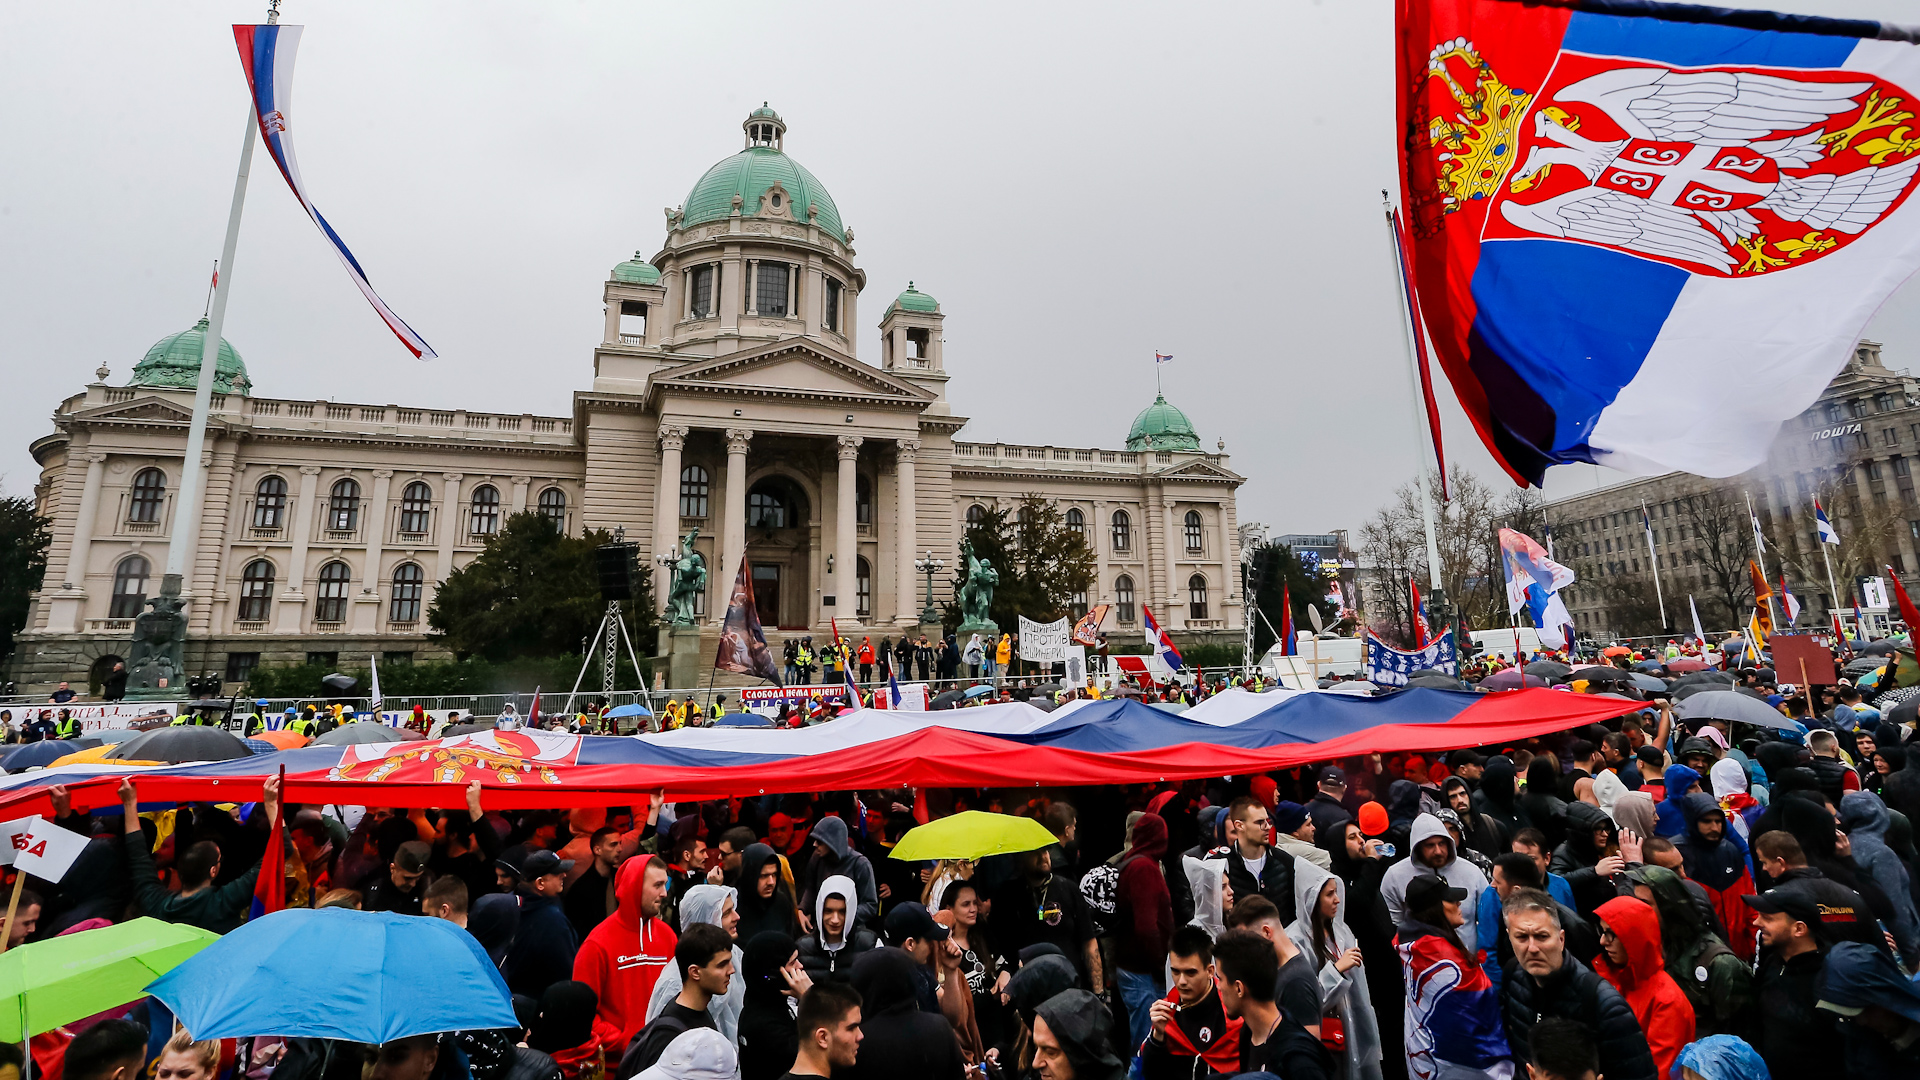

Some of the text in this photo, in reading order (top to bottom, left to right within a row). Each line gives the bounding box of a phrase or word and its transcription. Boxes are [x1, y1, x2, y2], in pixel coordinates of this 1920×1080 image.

[1811, 423, 1862, 441] ПОШТА
[1024, 633, 1068, 646] ПРОТИВ
[1020, 645, 1066, 659] МАШИНЕРИЈ
[746, 690, 784, 699] СЛОБОДА
[786, 688, 808, 697] НЕМА
